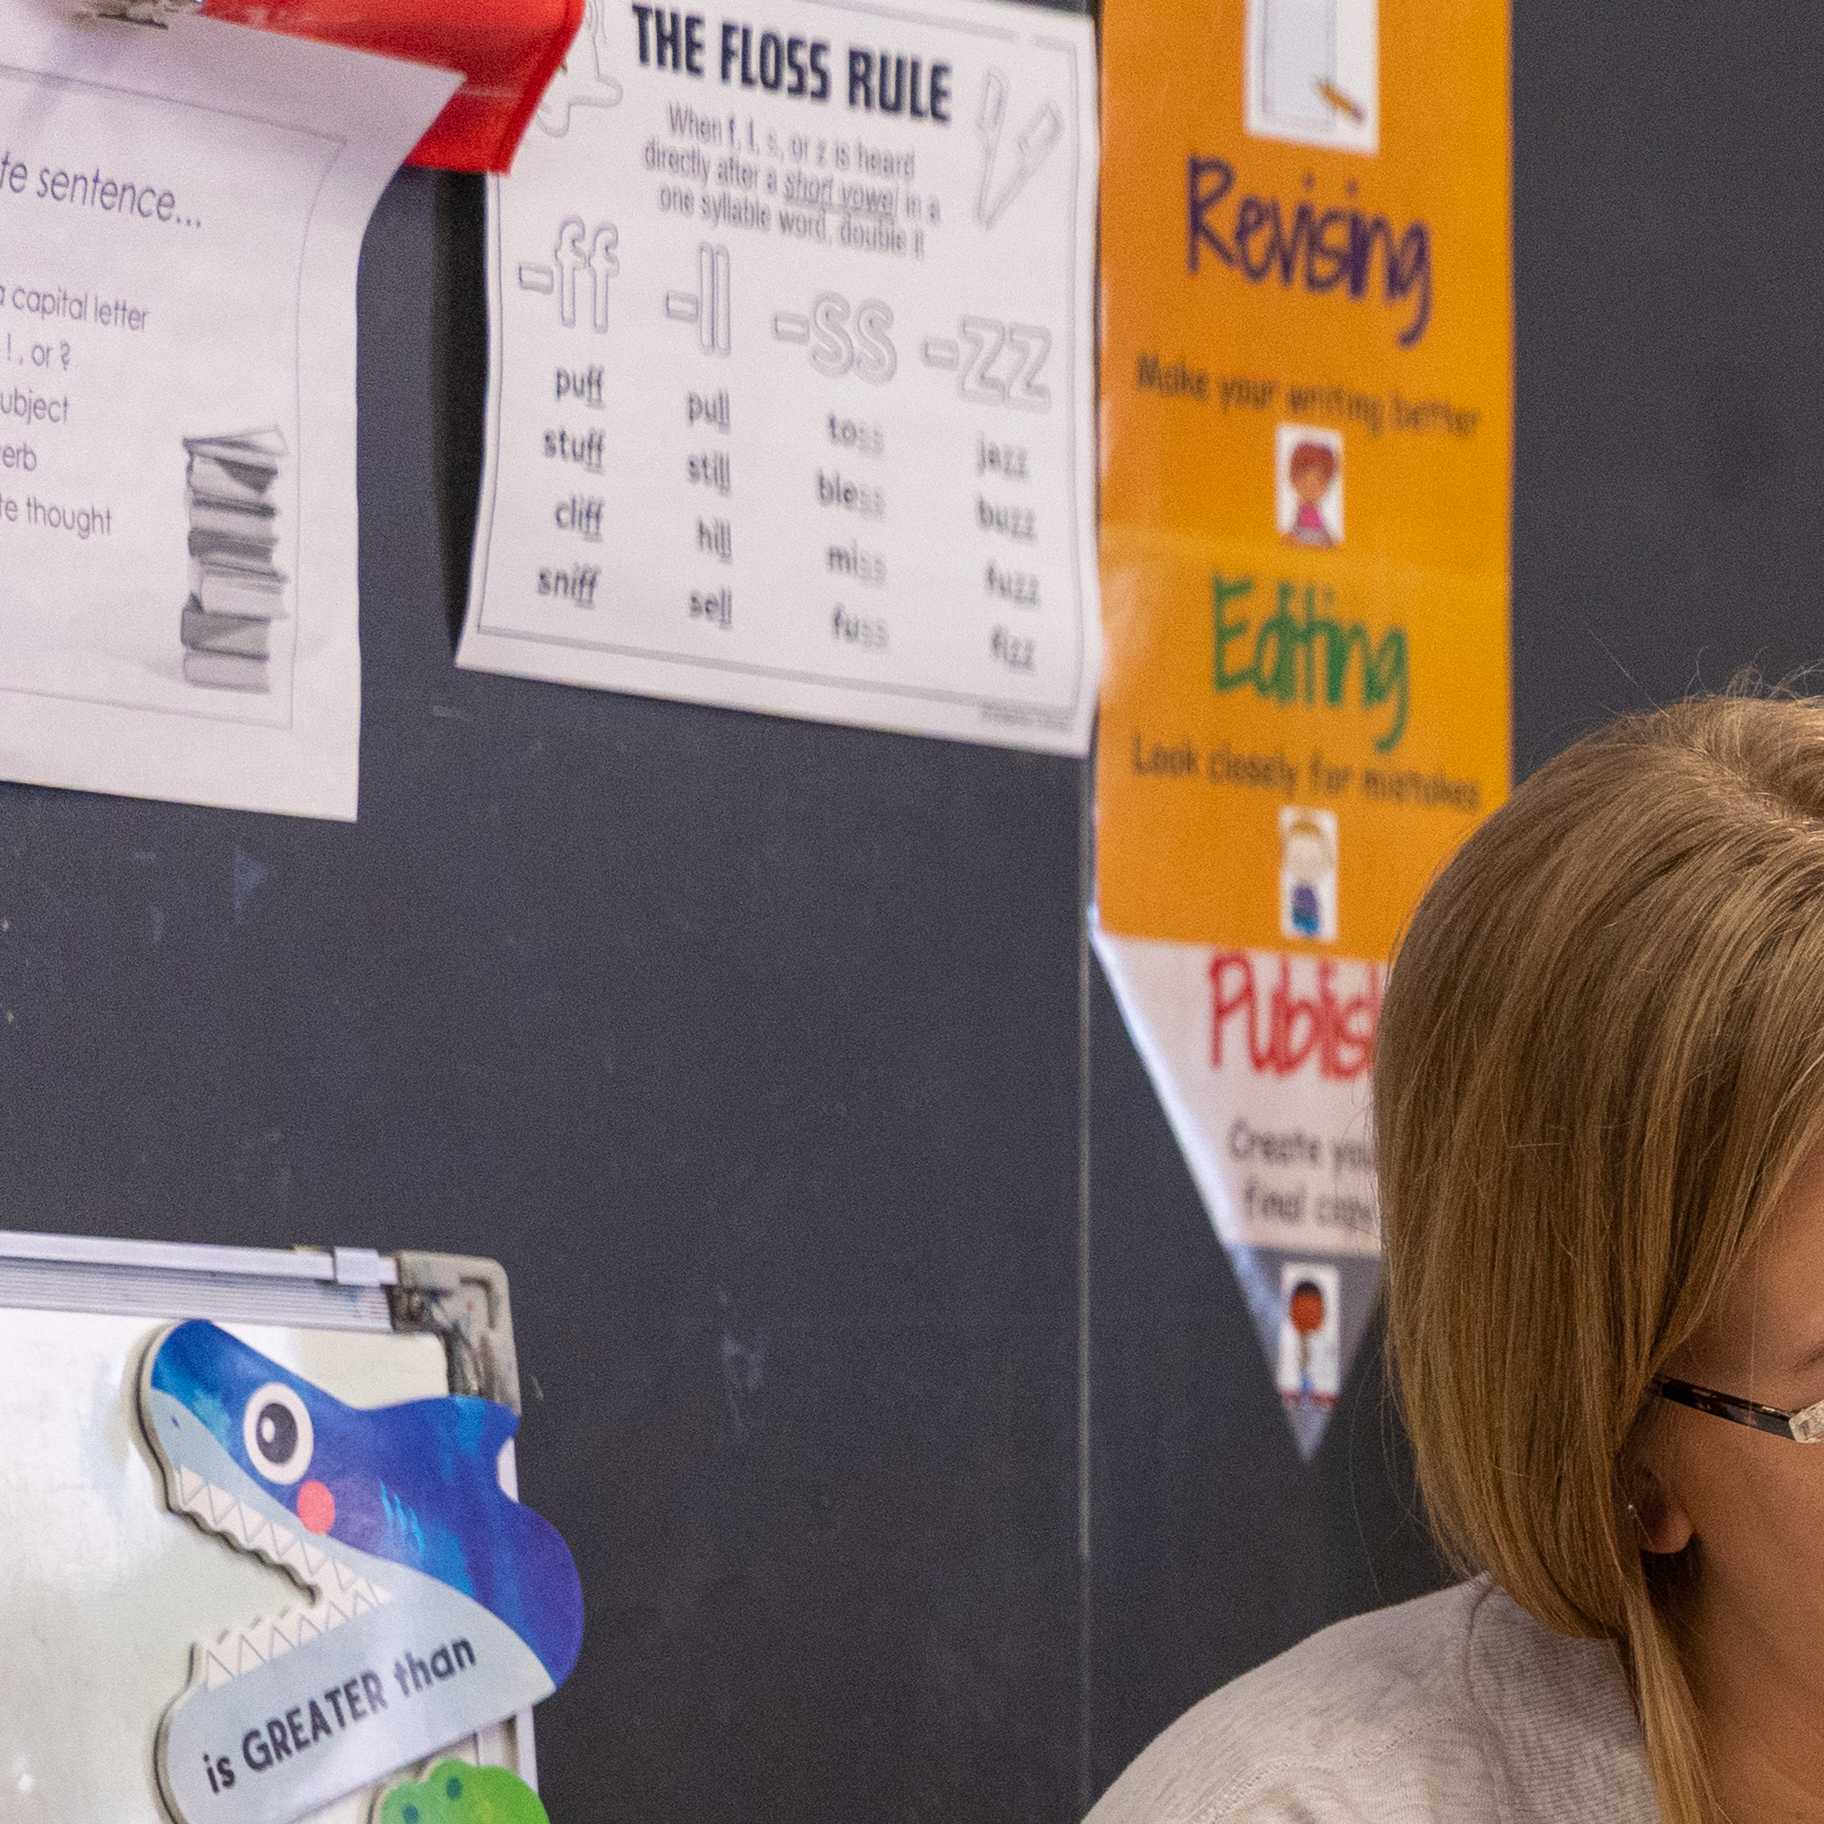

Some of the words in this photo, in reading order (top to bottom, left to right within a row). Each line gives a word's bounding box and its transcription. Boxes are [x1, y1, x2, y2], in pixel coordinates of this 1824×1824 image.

[632, 4, 706, 79] THE
[720, 20, 832, 103] FLOSS
[848, 46, 953, 124] RULE
[36, 166, 202, 229] sentence...
[1187, 153, 1433, 349] Revising
[12, 285, 89, 321] capital
[94, 295, 150, 331] letter
[31, 344, 53, 369] or
[0, 386, 70, 425] ubject
[555, 365, 606, 405] puff
[688, 389, 731, 430] pull
[1, 441, 38, 471] erb
[543, 427, 606, 472] stuff
[688, 452, 731, 495] still
[26, 495, 112, 540] thought
[555, 498, 604, 540] cliff
[696, 517, 732, 561] hill
[538, 565, 600, 607] sniff
[688, 590, 732, 628] sell
[1210, 569, 1411, 755] Editing
[1208, 948, 1382, 1080] Publis
[203, 1753, 235, 1795] is
[241, 1670, 388, 1774] GREATER
[393, 1637, 477, 1700] than
